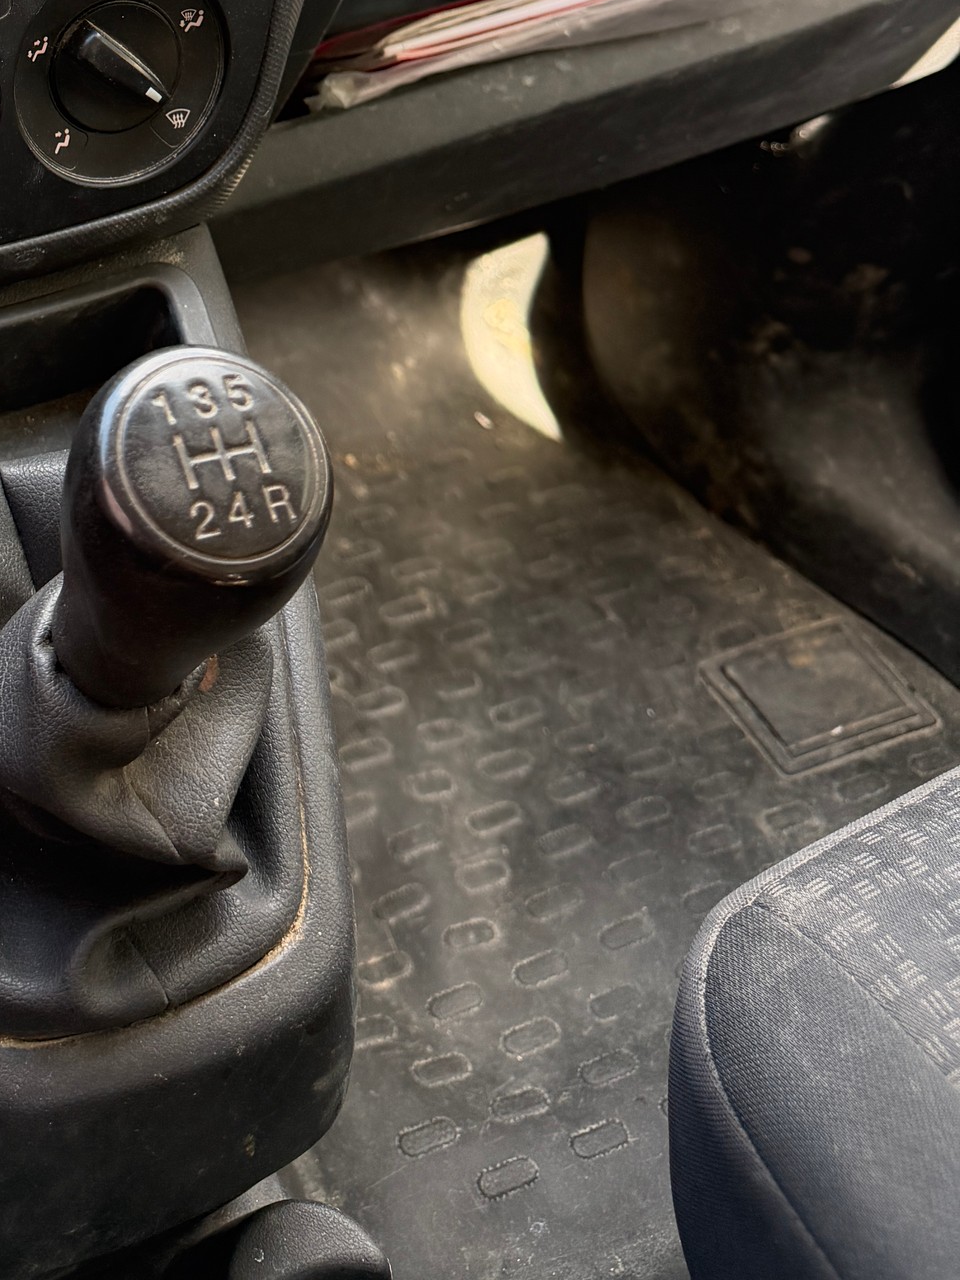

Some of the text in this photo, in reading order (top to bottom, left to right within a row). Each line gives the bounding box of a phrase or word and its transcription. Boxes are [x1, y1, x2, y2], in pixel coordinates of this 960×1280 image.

[151, 373, 255, 425] 1 3 5
[190, 484, 297, 540] 2 4 R
